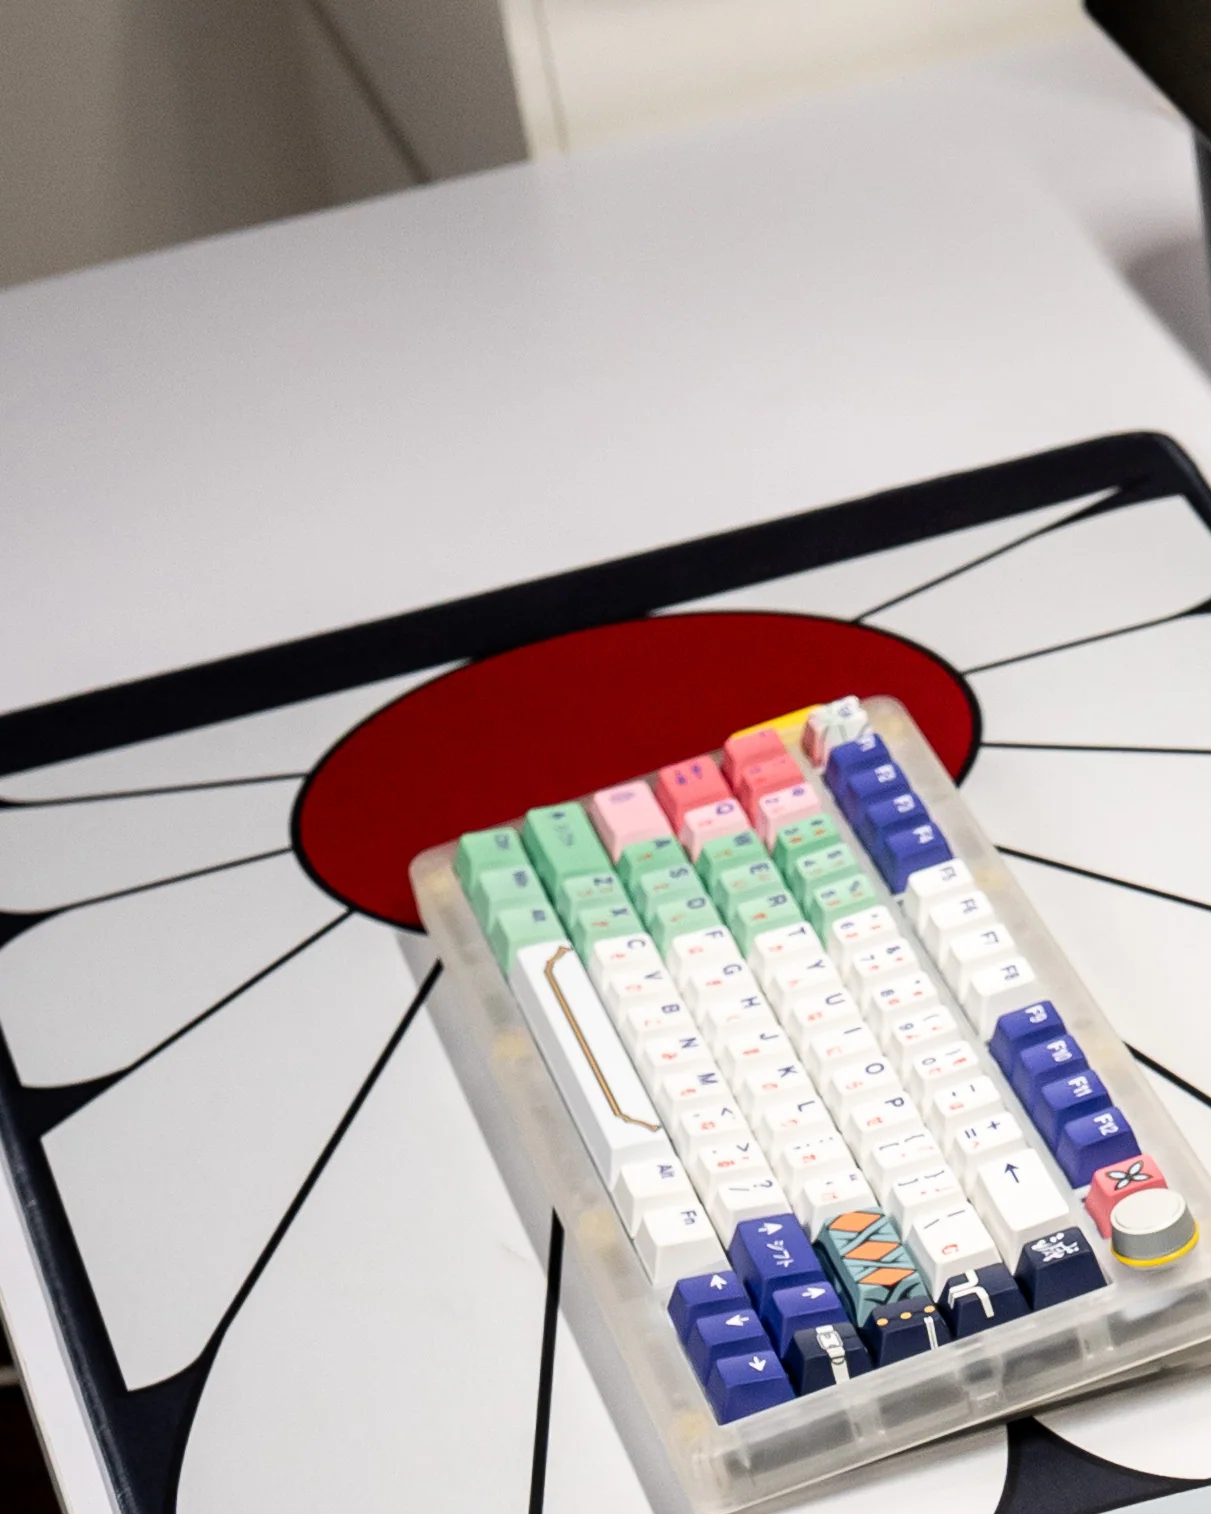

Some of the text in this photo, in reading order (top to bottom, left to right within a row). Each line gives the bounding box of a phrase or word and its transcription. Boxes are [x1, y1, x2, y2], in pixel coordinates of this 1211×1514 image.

[654, 838, 672, 849] A
[670, 867, 688, 878] S
[960, 899, 978, 914] F6
[706, 930, 724, 938] F
[788, 927, 806, 936] T
[627, 939, 646, 948] C
[981, 931, 999, 945] F7
[860, 954, 875, 962] 7
[723, 964, 742, 976] G
[807, 959, 826, 970] Y
[644, 971, 663, 980] V
[1001, 965, 1019, 981] F8
[741, 996, 761, 1008] H
[825, 993, 845, 1005] U
[661, 1004, 680, 1014] B
[1025, 1005, 1047, 1024] F9
[900, 1022, 914, 1030] 9
[679, 1037, 700, 1048] N
[759, 1033, 779, 1041] J
[1047, 1040, 1072, 1062] F10
[922, 1057, 936, 1065] 0
[778, 1065, 798, 1077] K
[865, 1063, 884, 1074] O
[697, 1073, 719, 1085] M
[1068, 1076, 1093, 1098] F11
[797, 1100, 815, 1112] L
[885, 1097, 904, 1107] P
[987, 1120, 1000, 1130] +
[1093, 1112, 1119, 1136] F12
[965, 1128, 977, 1139] =
[657, 1164, 674, 1178] Alt
[753, 1180, 773, 1189] ?
[680, 1210, 697, 1225] Fn
[1031, 1233, 1079, 1261] 滅
[766, 1239, 794, 1268] シフト
